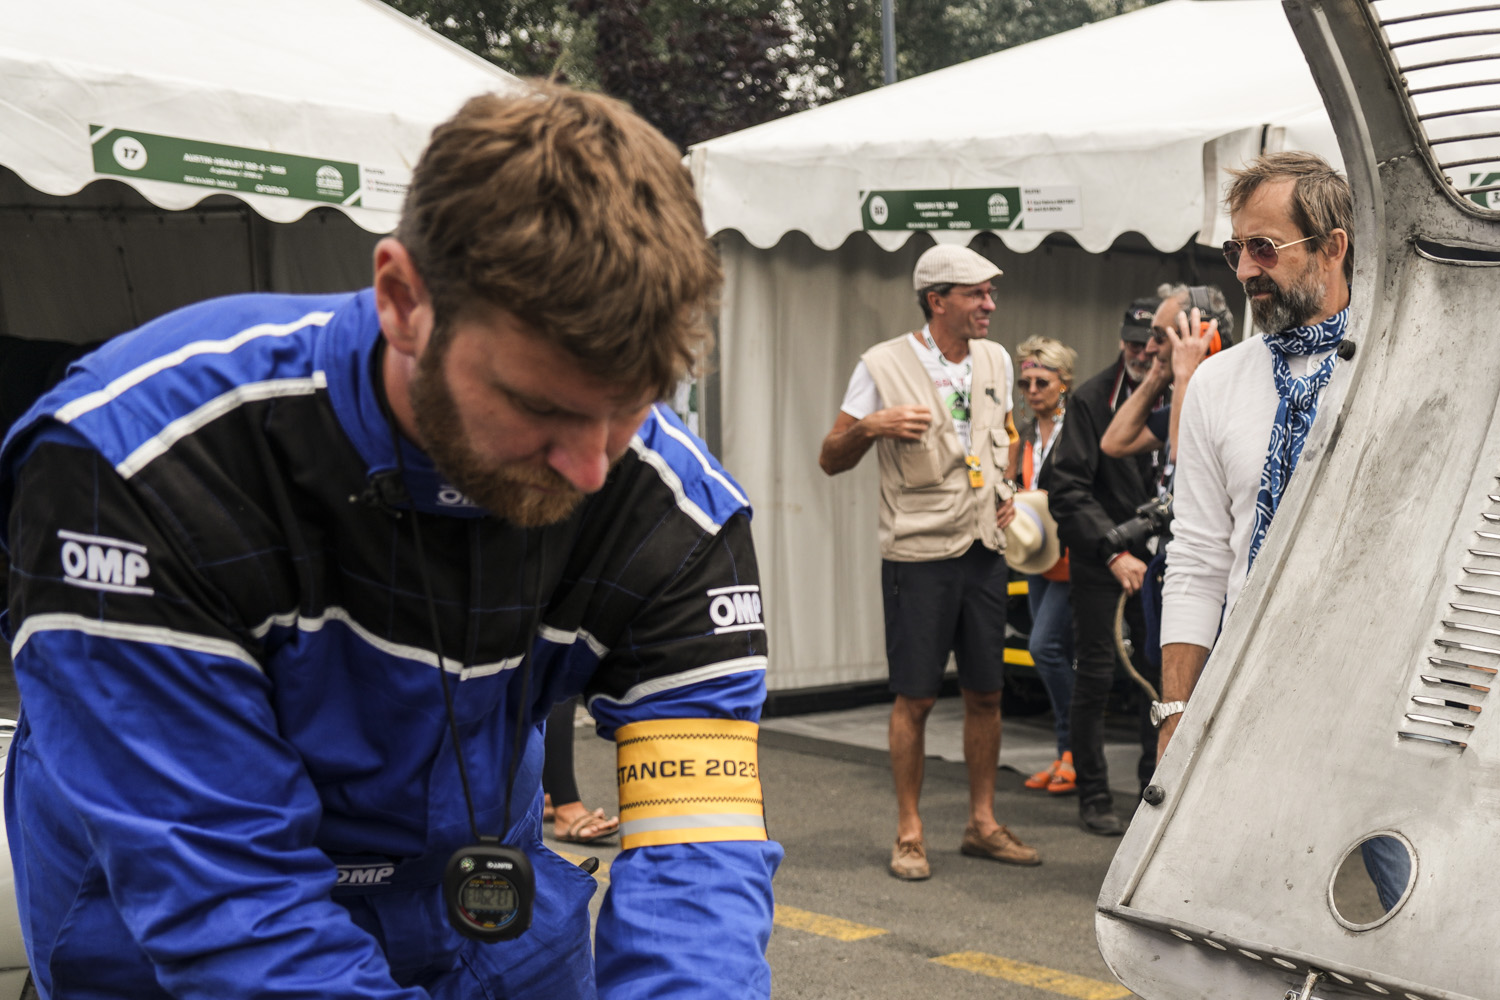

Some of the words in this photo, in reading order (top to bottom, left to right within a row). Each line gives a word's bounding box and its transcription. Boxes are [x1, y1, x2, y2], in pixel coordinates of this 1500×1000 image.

[123, 148, 138, 159] 17
[61, 540, 150, 587] OMP
[709, 592, 762, 627] OMP
[705, 759, 757, 779] 2023
